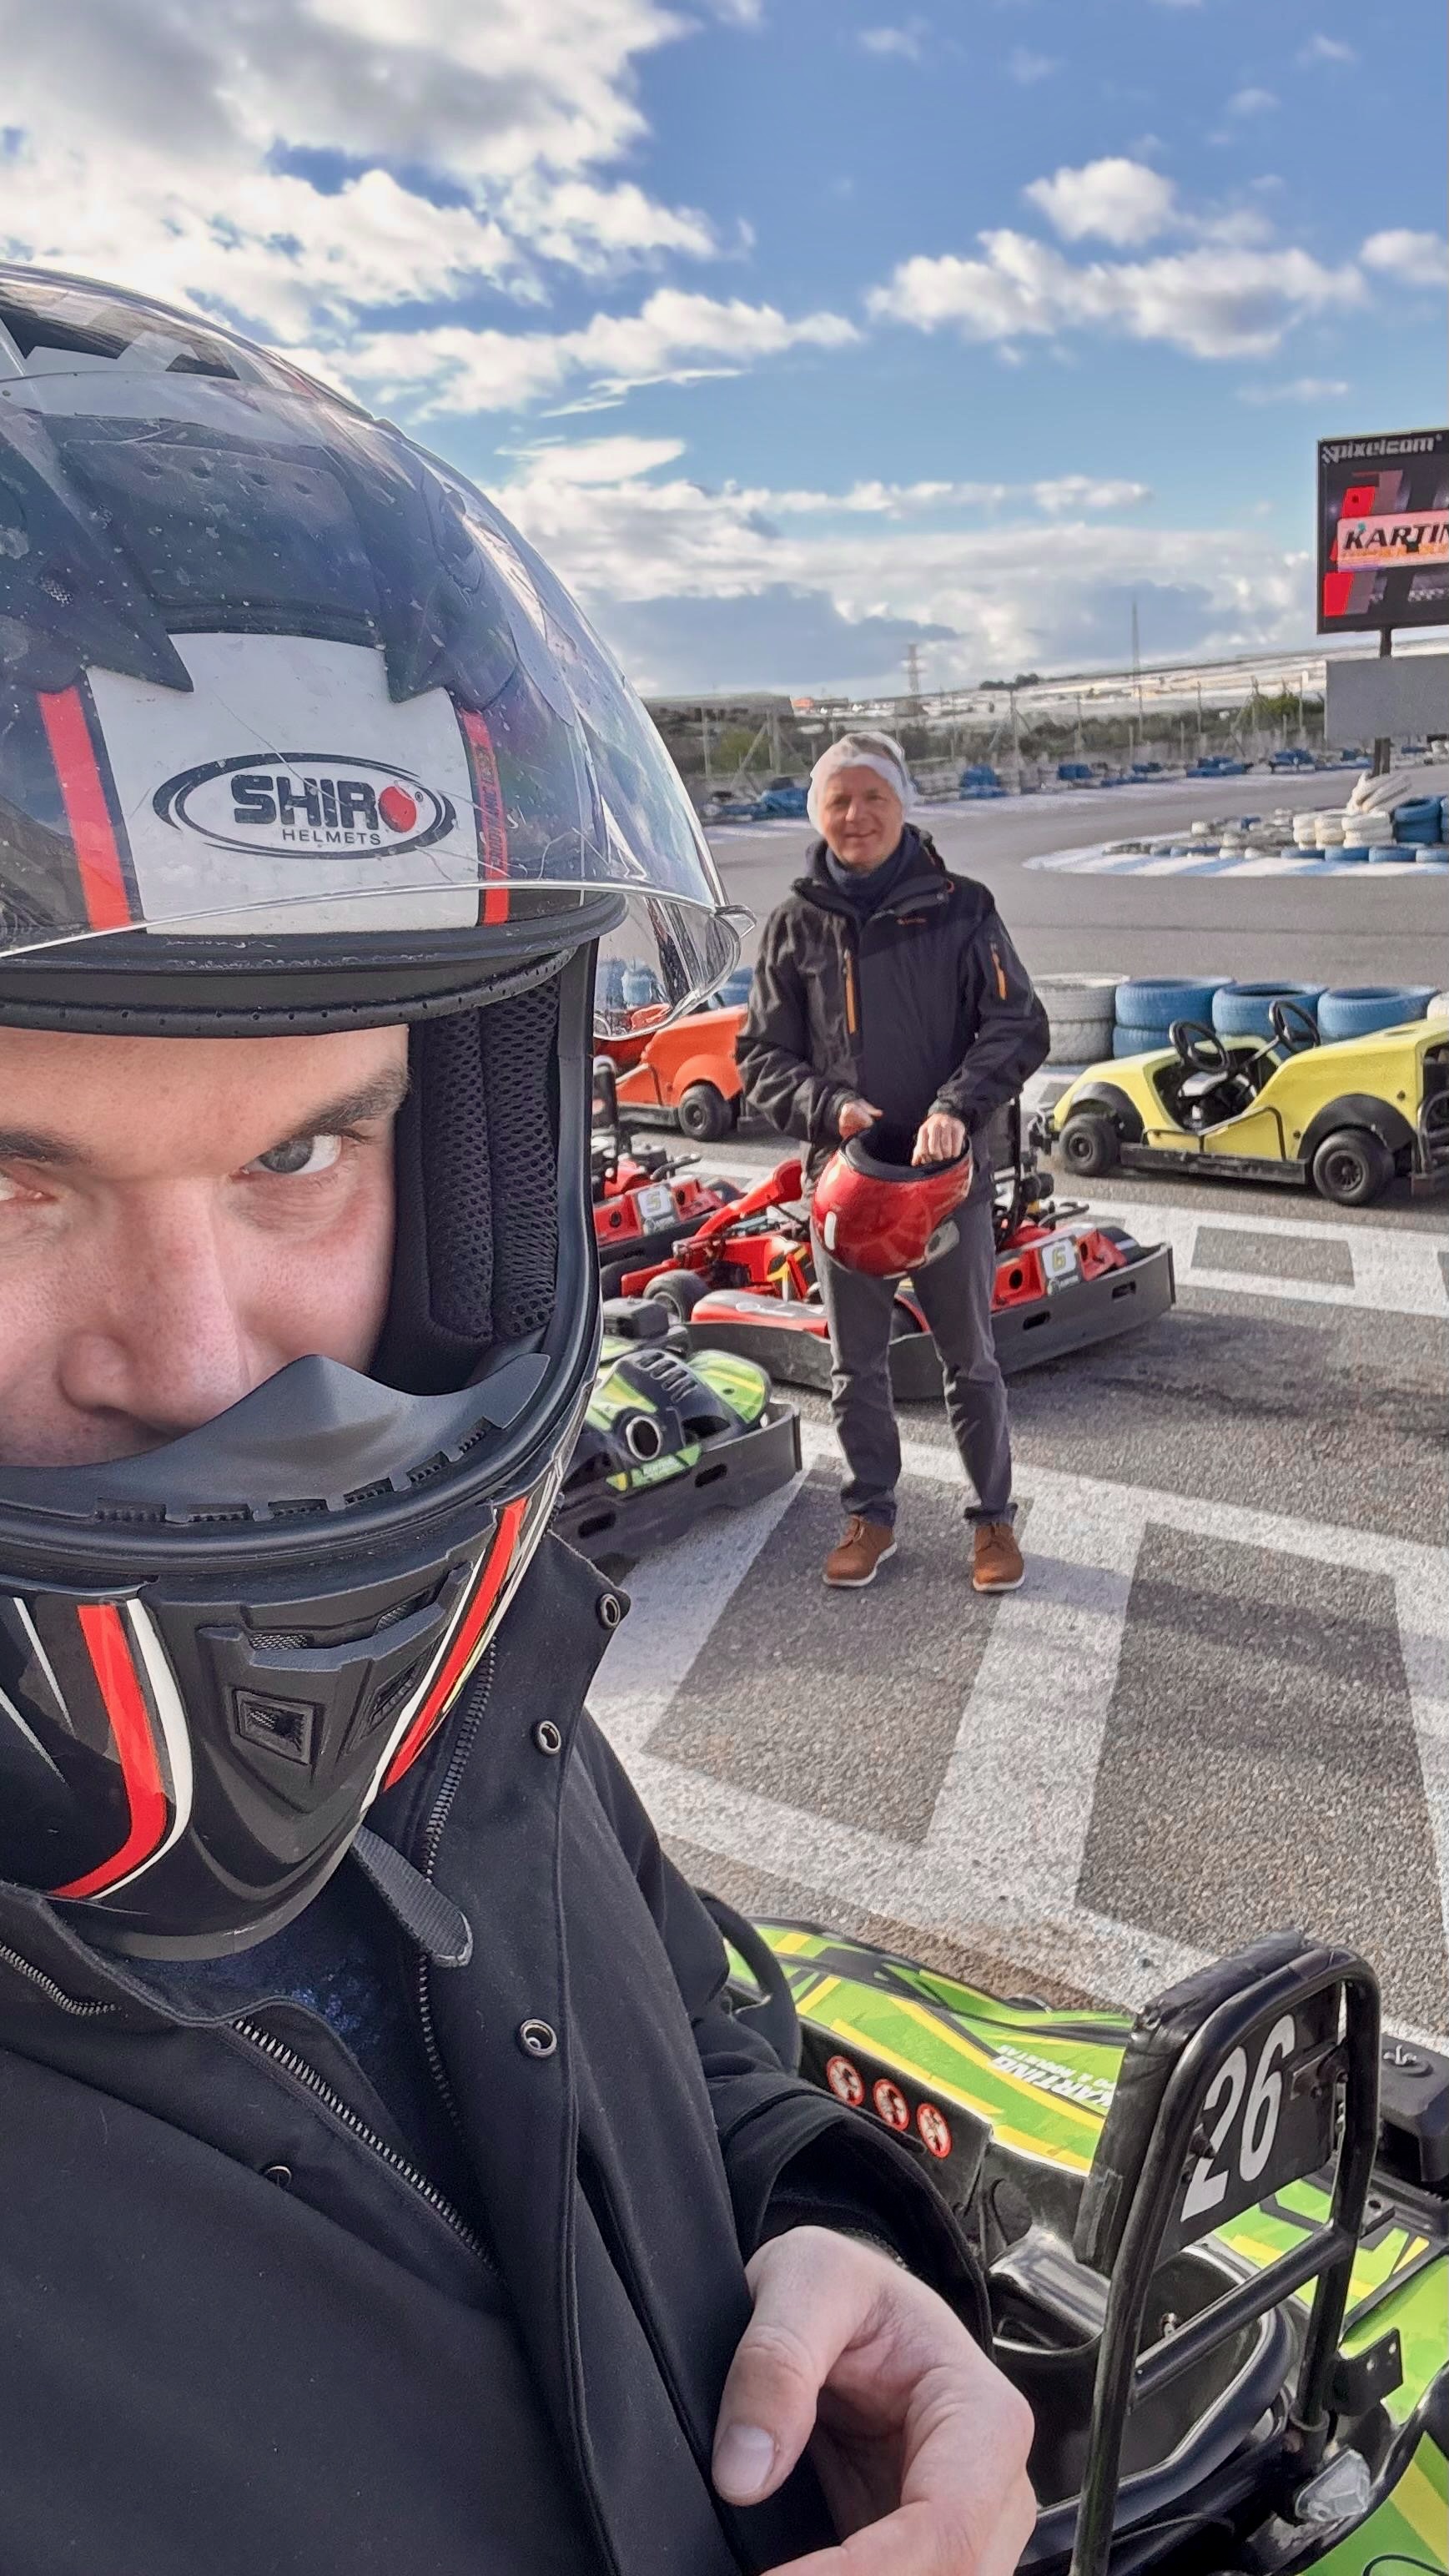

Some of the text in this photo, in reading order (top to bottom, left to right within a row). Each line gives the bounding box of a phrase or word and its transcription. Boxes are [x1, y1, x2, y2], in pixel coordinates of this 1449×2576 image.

[230, 774, 417, 833] SHIRO
[282, 828, 381, 846] HELMETS
[1052, 1244, 1067, 1272] 6
[1180, 2015, 1296, 2222] 26
